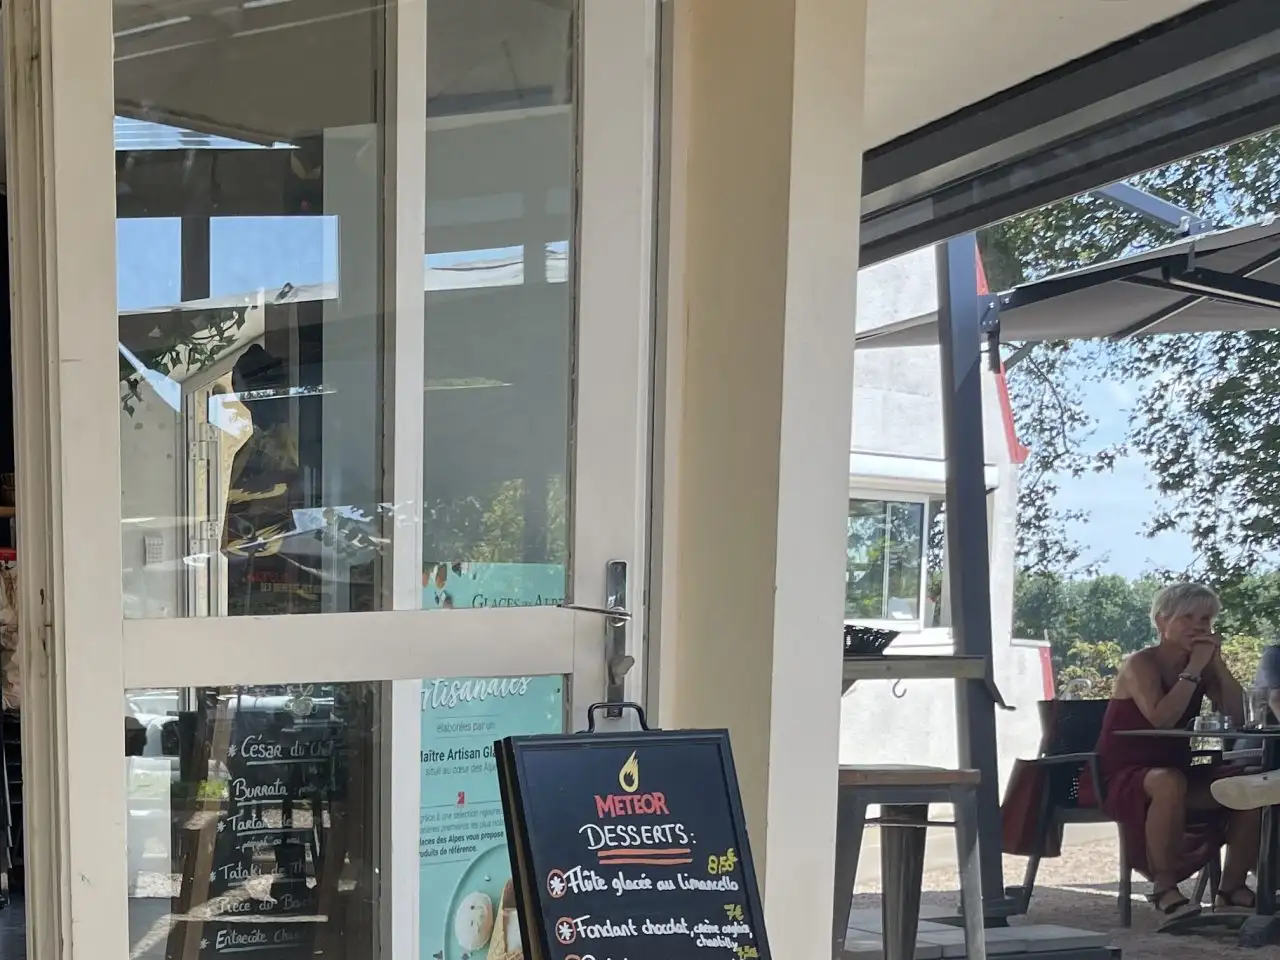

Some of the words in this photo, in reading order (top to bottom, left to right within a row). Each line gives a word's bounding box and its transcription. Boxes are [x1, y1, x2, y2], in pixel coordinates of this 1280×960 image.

[447, 747, 481, 762] Artisan
[594, 791, 669, 818] METEOR
[563, 865, 609, 894] Flûte
[611, 872, 653, 896] glacée
[656, 878, 676, 892] au
[572, 914, 638, 939] Fondant
